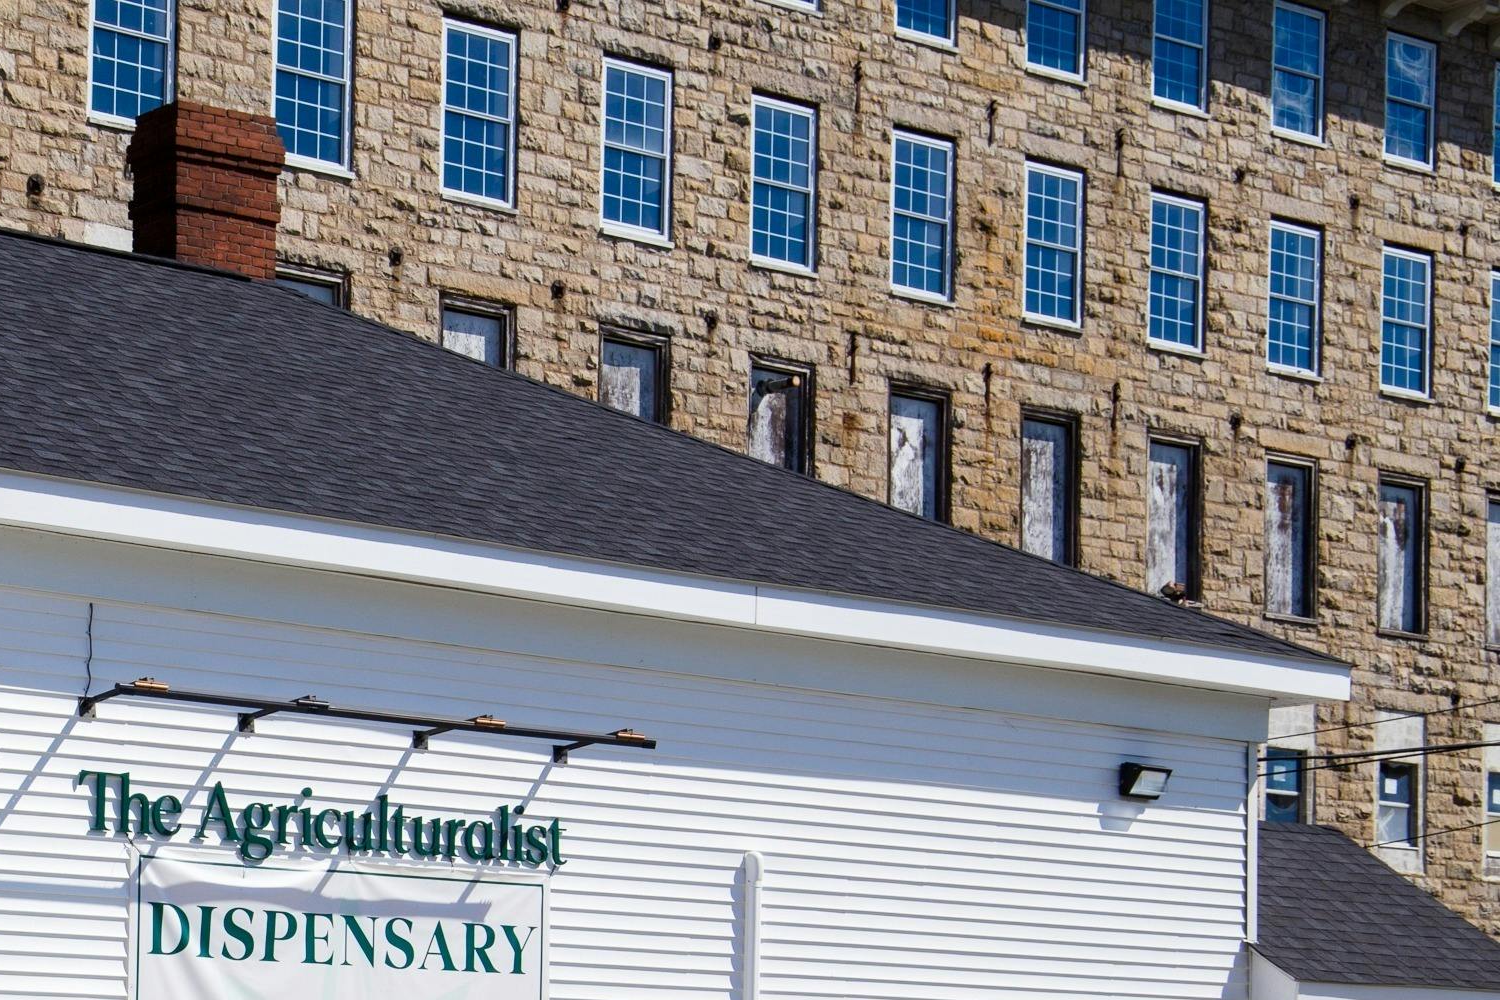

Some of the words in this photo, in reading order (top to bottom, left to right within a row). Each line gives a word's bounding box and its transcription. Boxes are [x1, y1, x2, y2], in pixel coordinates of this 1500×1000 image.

[78, 769, 182, 837] The
[197, 780, 568, 867] Agriculturalist
[147, 901, 538, 975] DISPENSARY
